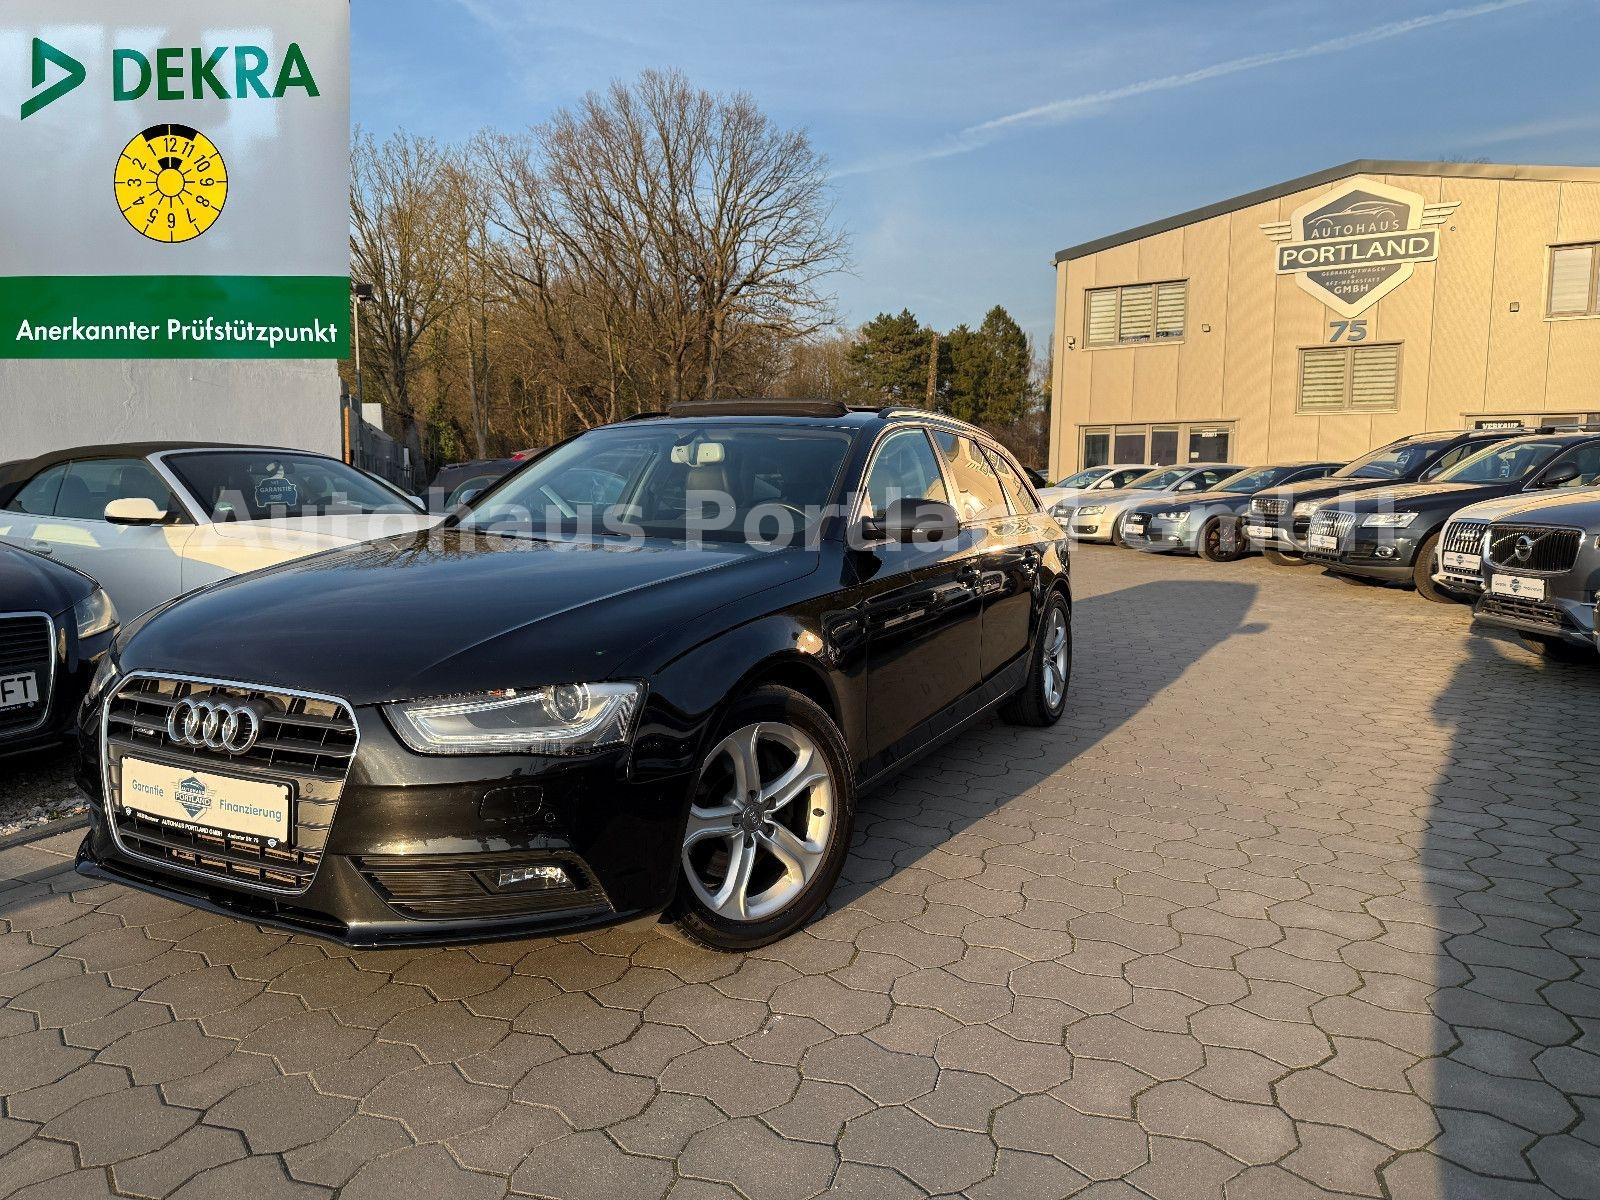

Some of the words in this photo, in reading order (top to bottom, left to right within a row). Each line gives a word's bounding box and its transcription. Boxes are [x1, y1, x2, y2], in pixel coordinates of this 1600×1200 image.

[1311, 219, 1400, 239] AUTOHAUS
[1282, 238, 1430, 267] PORTLAND
[1334, 284, 1369, 294] GMBH
[1329, 319, 1368, 342] 75
[1, 676, 31, 703] FT
[132, 779, 164, 797] Garantie
[175, 792, 211, 806] PORTLAND
[219, 799, 282, 823] Finanzierung
[162, 819, 184, 829] AUTOHAUS
[185, 824, 208, 835] PORTLAND
